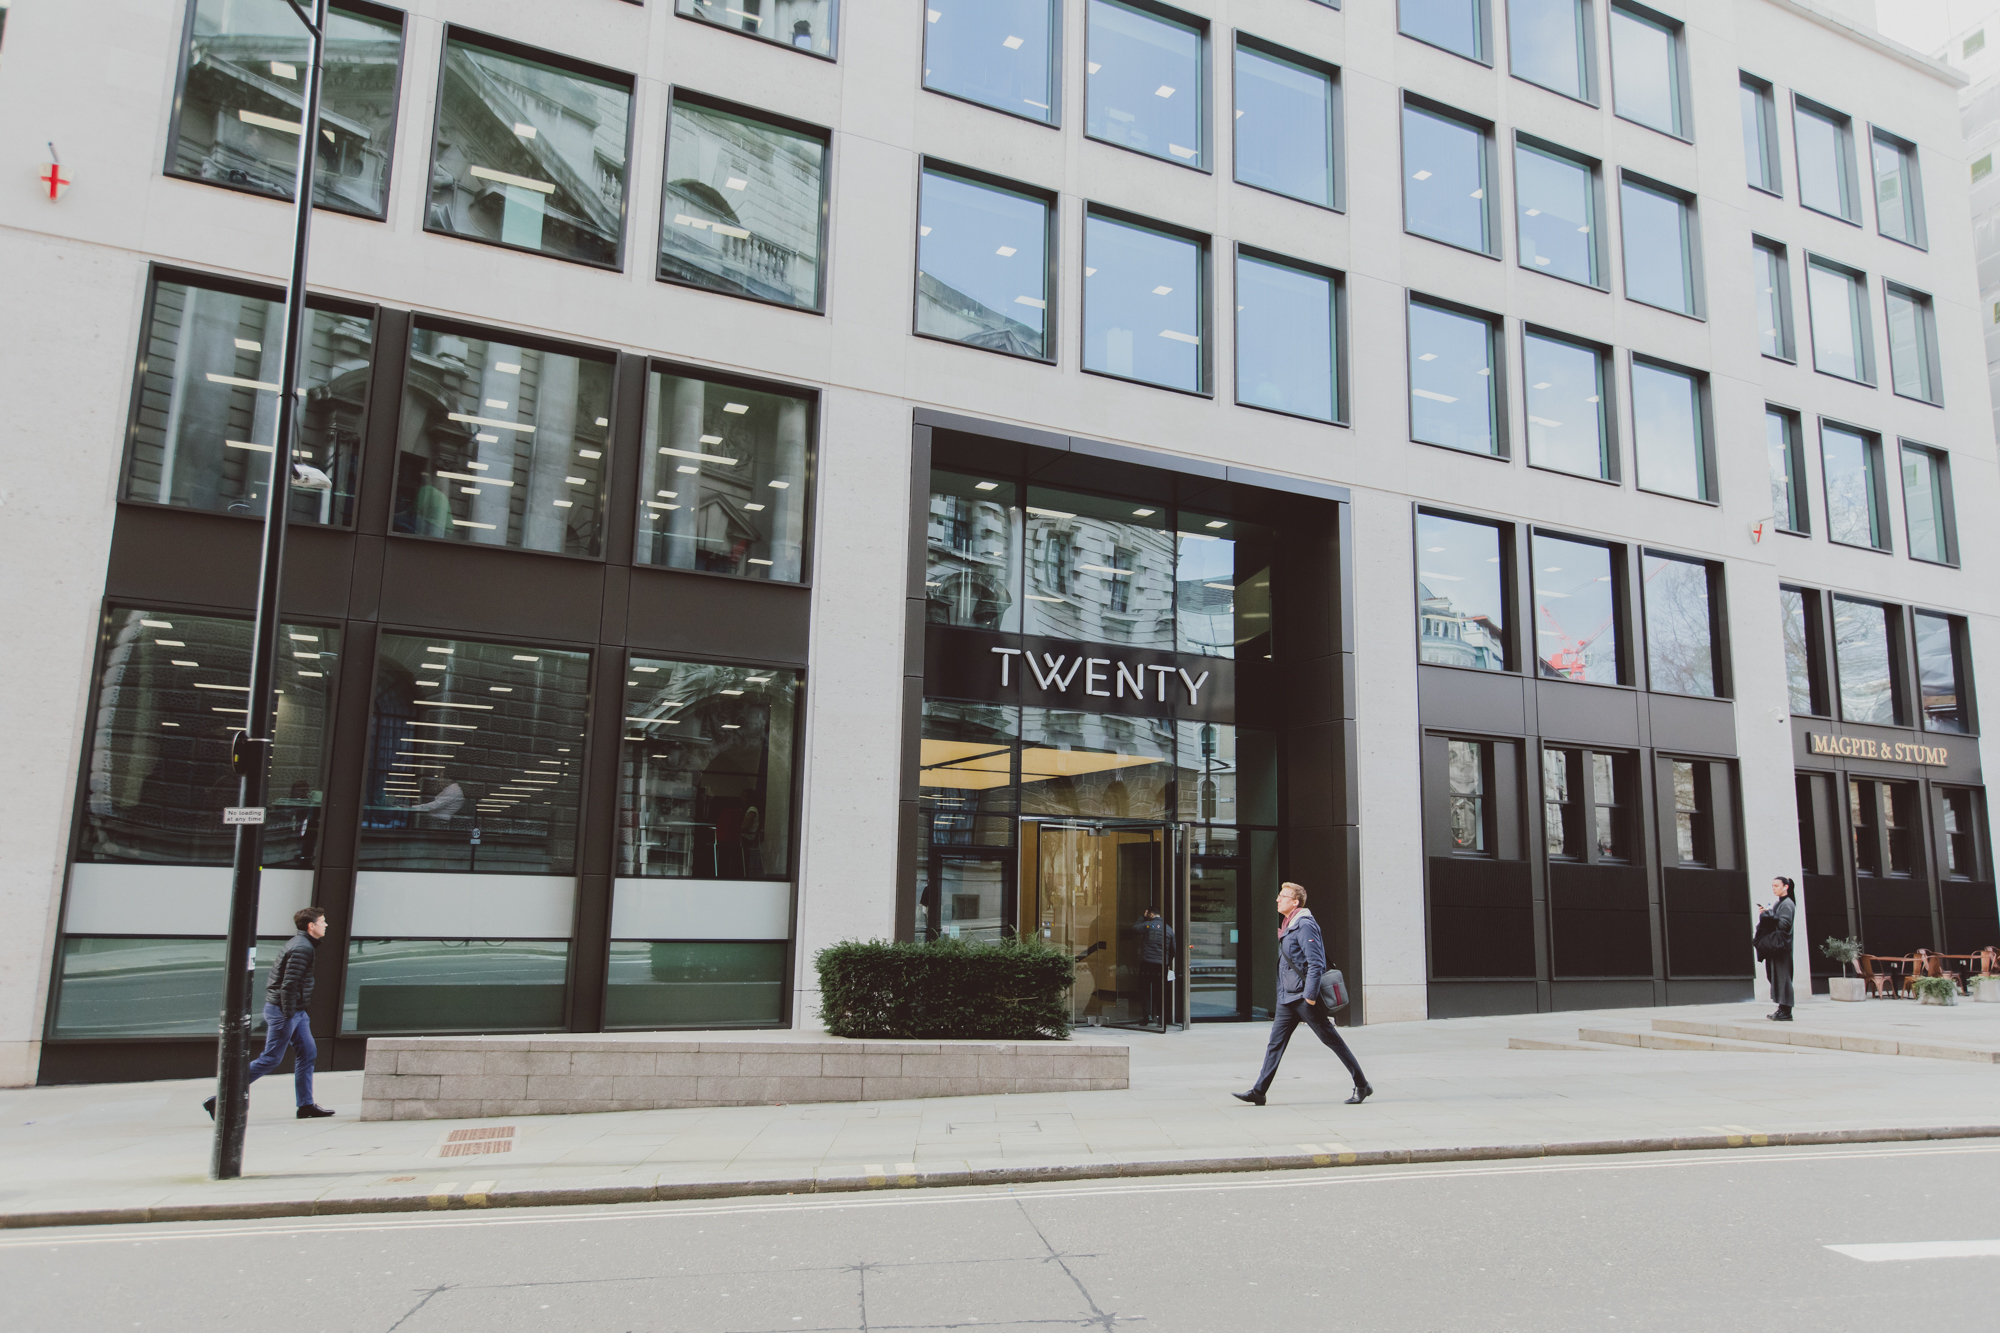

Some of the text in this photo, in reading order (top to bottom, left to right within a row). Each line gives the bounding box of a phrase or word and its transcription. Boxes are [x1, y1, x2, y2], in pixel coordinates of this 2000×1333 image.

[991, 647, 1209, 705] TWENTY
[1813, 734, 1948, 765] MAGPIE & STUMP
